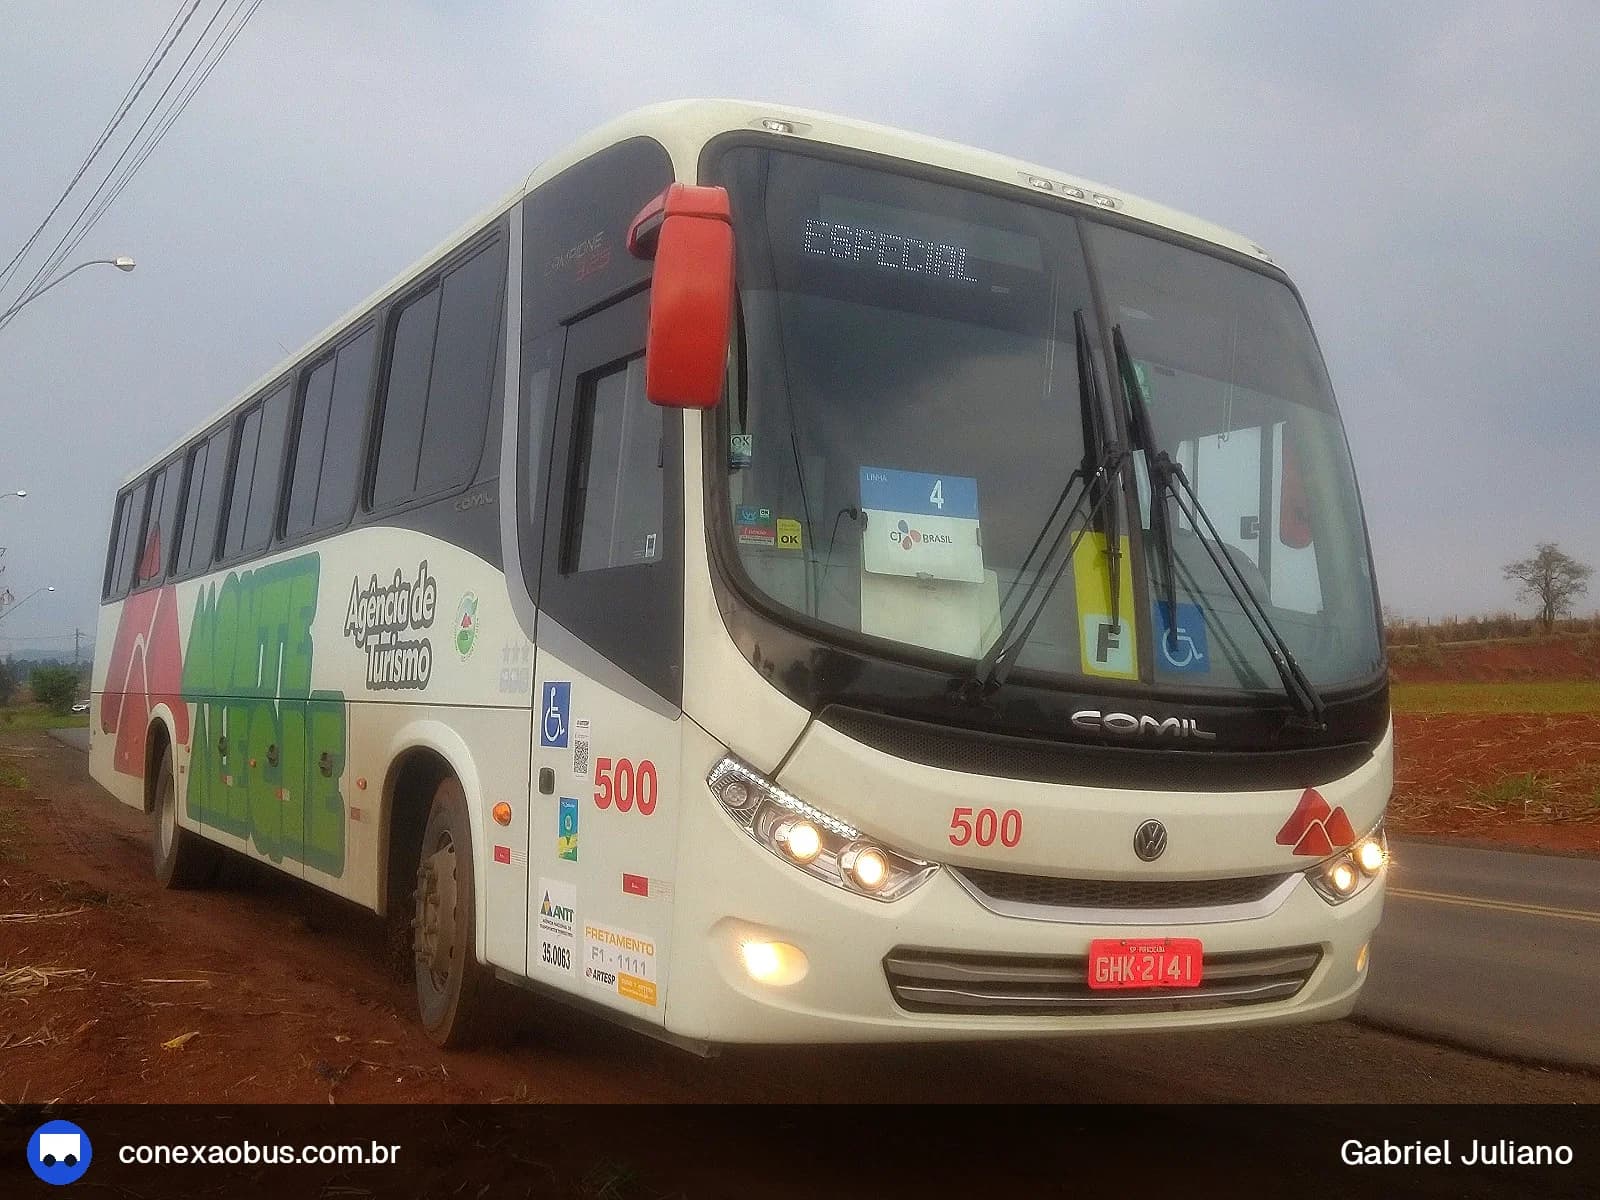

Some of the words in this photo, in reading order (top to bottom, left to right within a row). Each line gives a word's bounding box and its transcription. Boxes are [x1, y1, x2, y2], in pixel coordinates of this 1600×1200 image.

[804, 219, 978, 282] ESPECIAL
[929, 479, 945, 510] 4
[781, 535, 799, 544] OK
[890, 531, 902, 543] CJ
[922, 534, 953, 544] BRASIL
[344, 567, 411, 649] Agência
[410, 559, 438, 629] de
[1096, 623, 1121, 663] F
[365, 634, 433, 691] Turismo
[1071, 710, 1217, 740] COMIL
[593, 757, 659, 816] 500
[949, 807, 1023, 848] 500
[553, 905, 575, 923] ANTT
[542, 941, 571, 970] 35.0063
[585, 926, 655, 956] FRETAMENTO
[591, 946, 605, 963] F1
[617, 954, 646, 976] 1111
[592, 968, 616, 986] ARTESP
